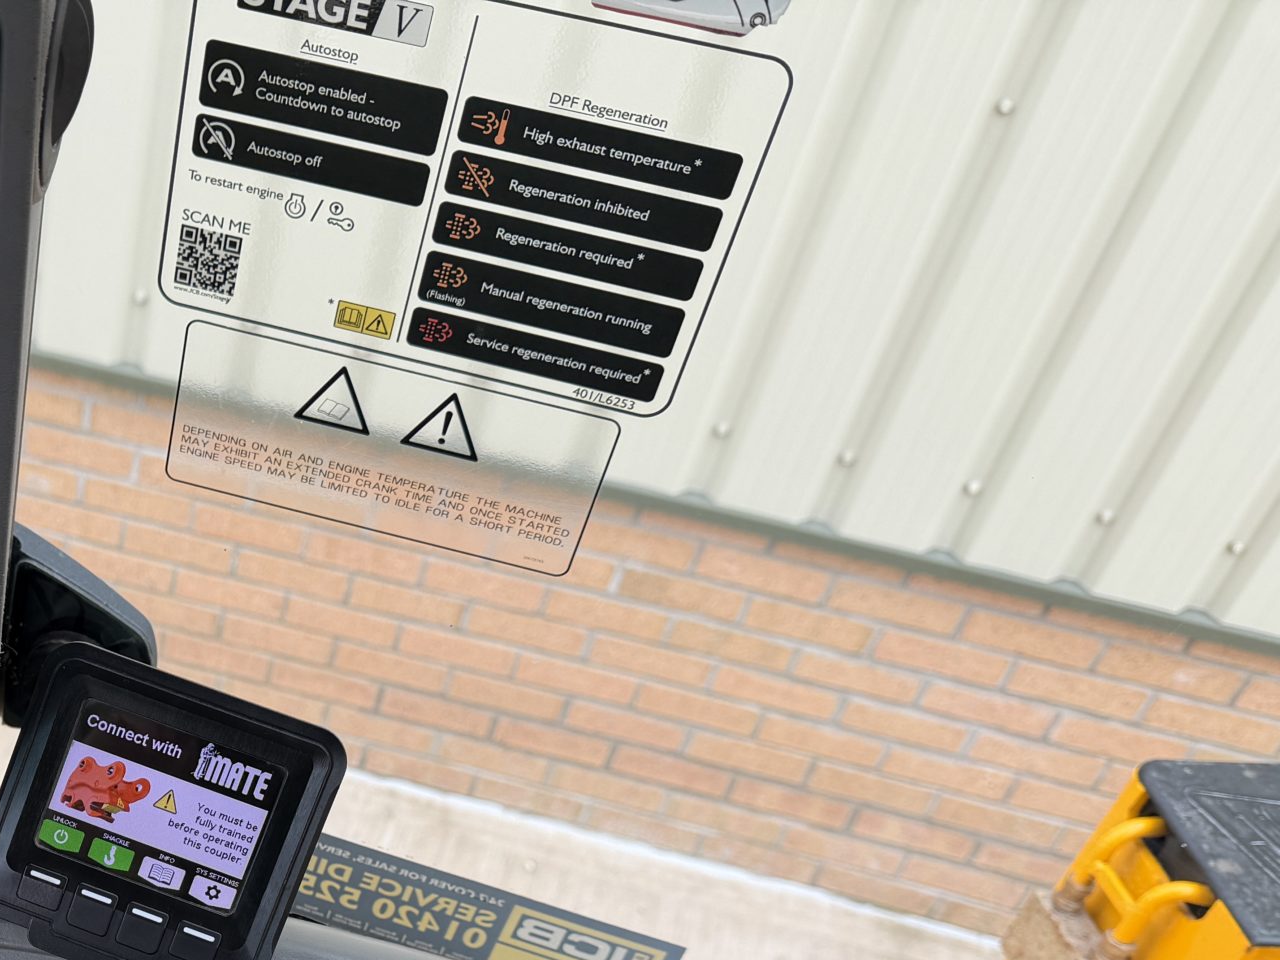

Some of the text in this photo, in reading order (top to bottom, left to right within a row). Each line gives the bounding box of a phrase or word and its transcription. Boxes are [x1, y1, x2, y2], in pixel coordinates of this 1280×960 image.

[246, 0, 423, 38] AGE V
[300, 39, 359, 64] Autostop
[258, 70, 315, 95] Autostop
[318, 83, 367, 105] enabled
[255, 87, 401, 132] Countdown to autostop
[549, 92, 668, 131] DPF Regeneration
[247, 140, 323, 168] Autostop off
[523, 126, 692, 175] High exhaust temperature
[188, 169, 284, 202] To restart engine
[508, 177, 650, 221] Regeneration inhibited
[182, 208, 251, 235] SCAN ME
[495, 226, 634, 270] Regeneration required
[426, 289, 466, 307] (Flashing)
[480, 281, 653, 335] Manual regeneration running
[466, 333, 642, 386] Service regeneration required
[572, 386, 636, 411] 401/L6253
[181, 434, 570, 539] MAY EXHIBIT AN EXTENDED CRANK TIME AND ONCE STARTED
[183, 424, 563, 526] DEPENDING ON AIR AND ENGINE TEMPERATURE THE MACHINE
[179, 444, 565, 548] ENGINE SPEED MAY BE LIMITED TO IDLE FOR A SHORT PERIOD.
[86, 713, 183, 760] Connect with
[53, 814, 78, 829] UNLOCK
[195, 815, 254, 844] fully trained
[197, 802, 258, 832] You must be
[102, 832, 131, 848] SHACKLE
[167, 817, 249, 856] before operating
[183, 836, 243, 866] this coupler.
[158, 853, 176, 864] INFO
[195, 867, 240, 888] SYS SETTINGS
